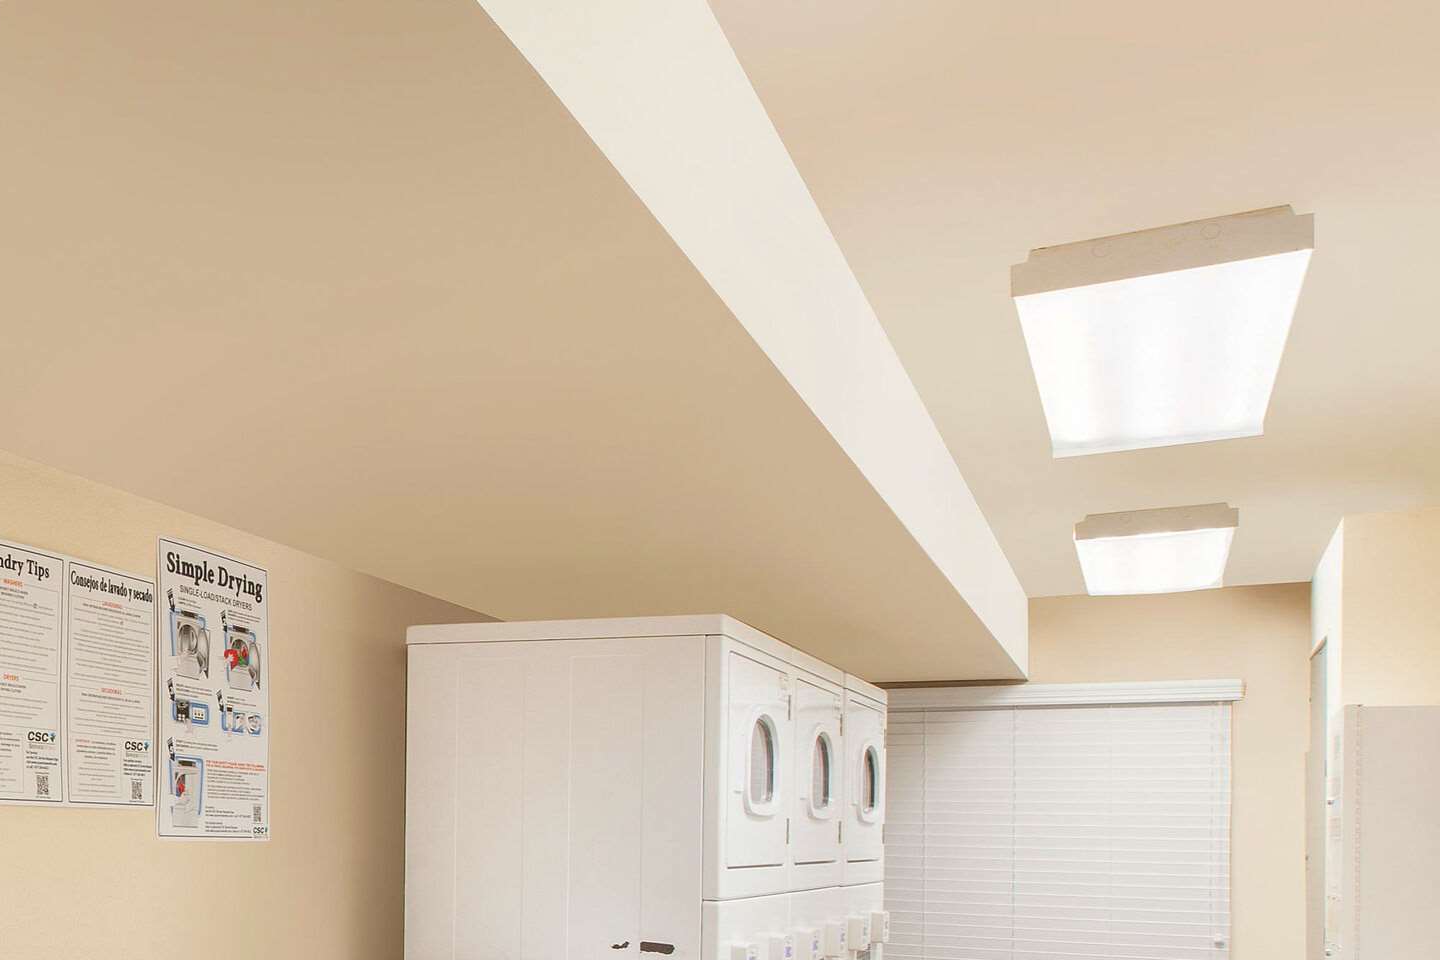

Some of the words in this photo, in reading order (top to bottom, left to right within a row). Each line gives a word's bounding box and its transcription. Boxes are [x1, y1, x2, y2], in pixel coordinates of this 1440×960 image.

[26, 559, 50, 581] Tips
[167, 551, 215, 586] Simple
[217, 566, 263, 603] Drying
[70, 570, 99, 593] Consejos
[99, 579, 108, 593] de
[107, 578, 128, 598] lavado
[128, 589, 133, 602] y
[133, 587, 153, 603] secado
[27, 731, 49, 742] CSC
[124, 741, 144, 752] CSC
